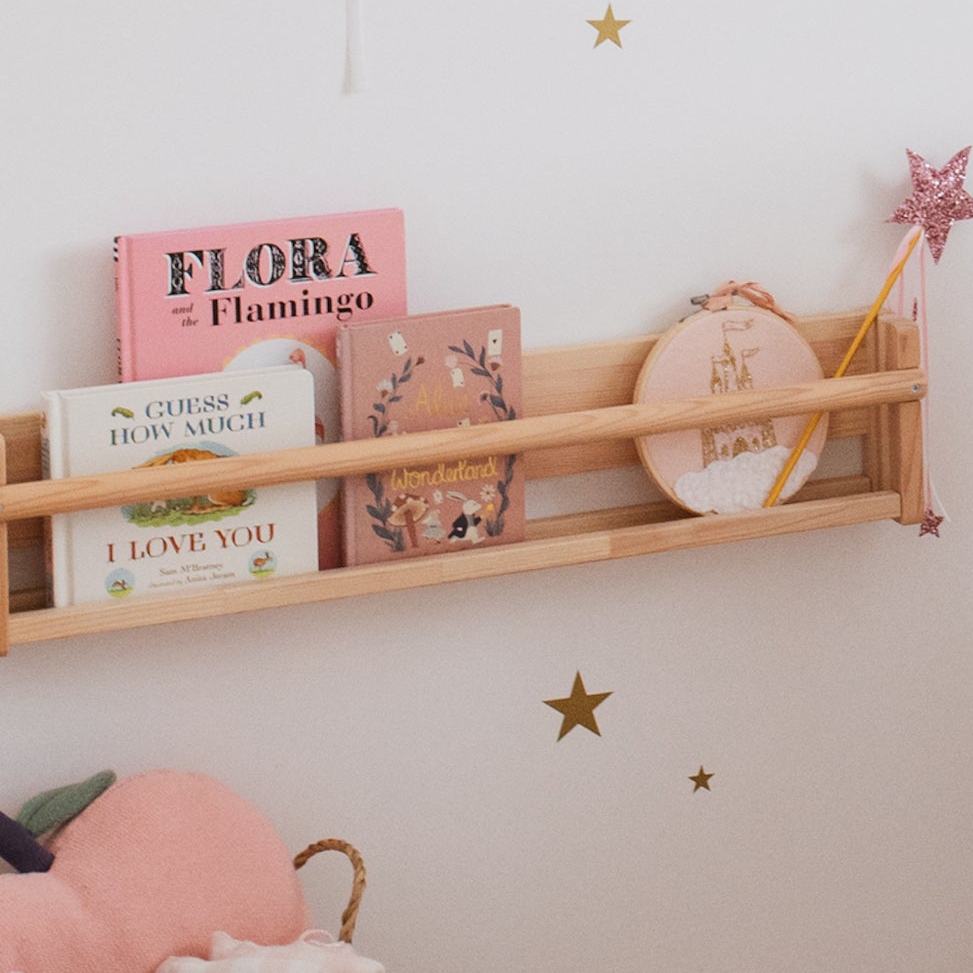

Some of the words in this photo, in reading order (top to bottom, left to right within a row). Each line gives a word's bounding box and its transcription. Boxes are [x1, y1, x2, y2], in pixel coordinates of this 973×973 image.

[164, 232, 379, 300] FLORA
[172, 302, 194, 315] and
[209, 289, 375, 327] Flamingo
[181, 316, 199, 327] the
[144, 393, 230, 420] GUESS
[109, 421, 174, 446] HOW
[184, 410, 267, 439] MUCH
[389, 456, 499, 491] Wonderland
[105, 543, 116, 564] I
[130, 532, 207, 562] LOVE
[214, 522, 277, 549] YOU
